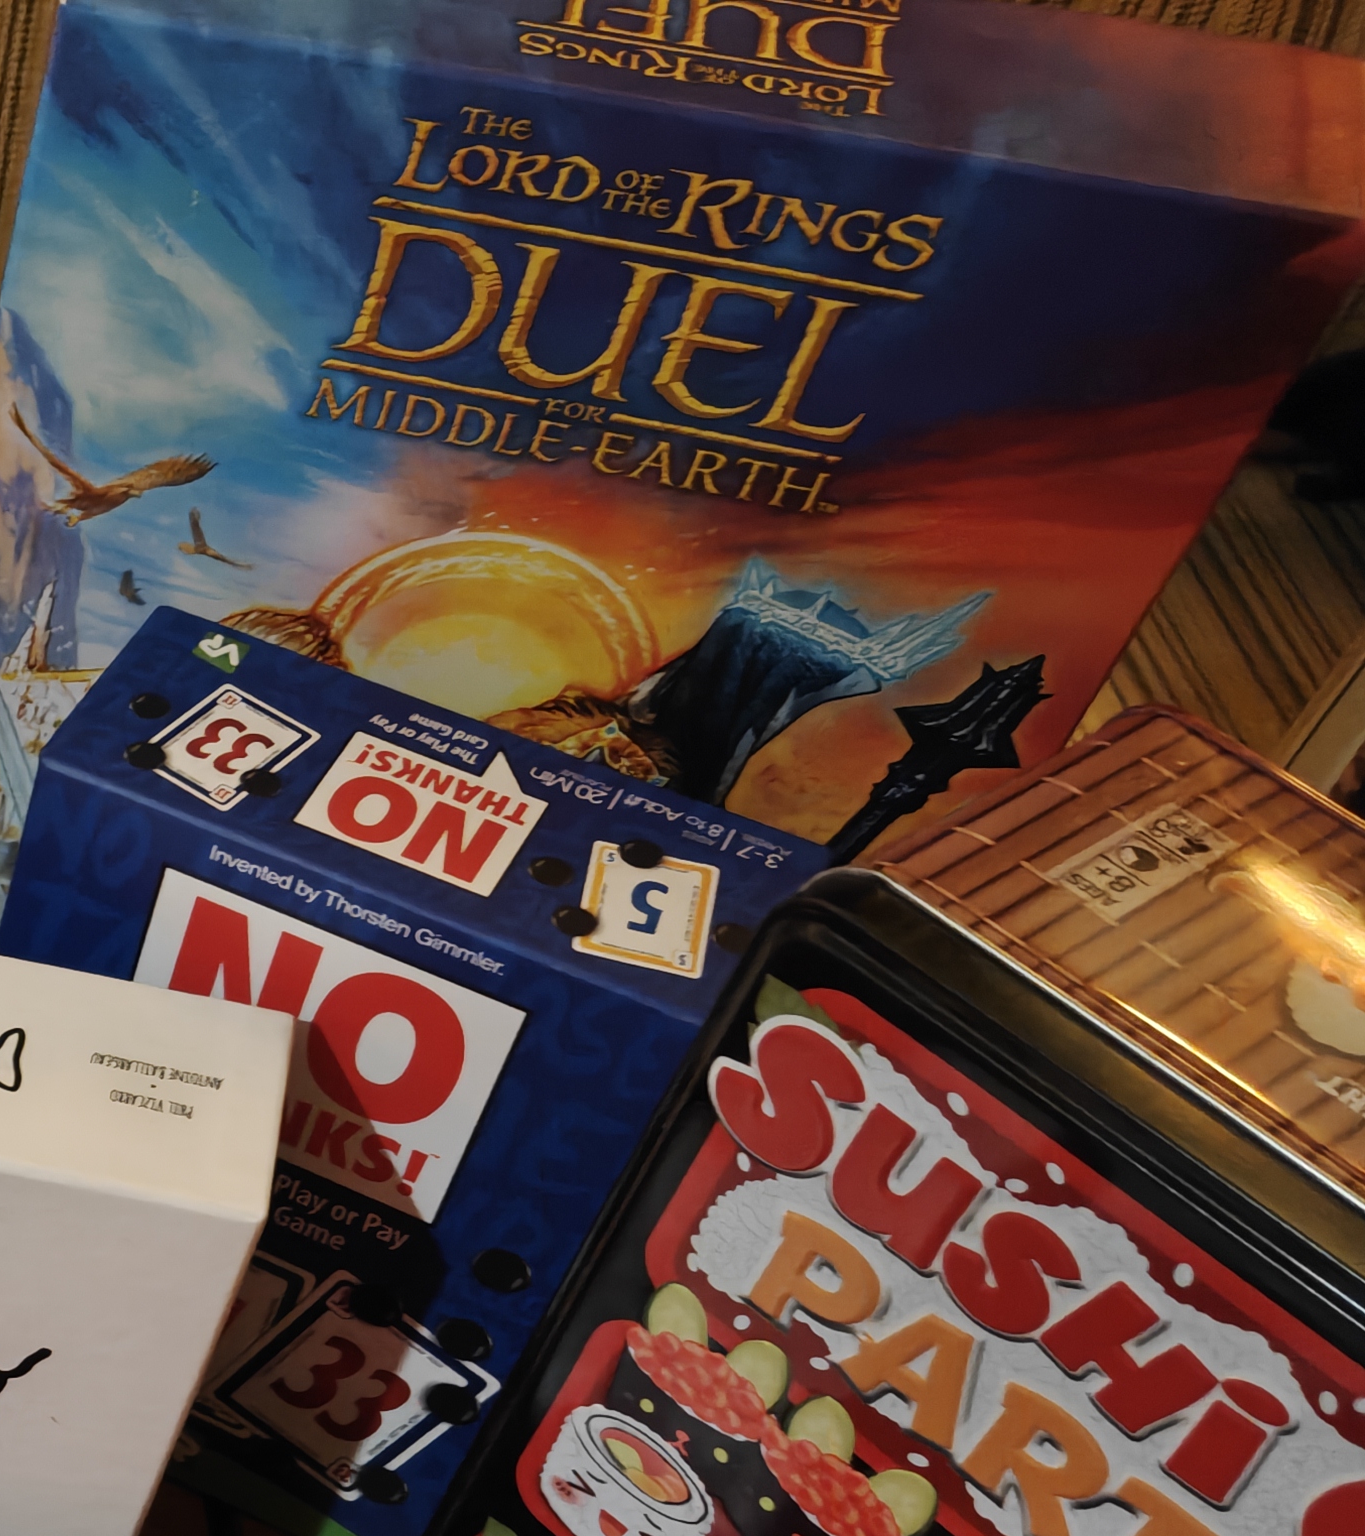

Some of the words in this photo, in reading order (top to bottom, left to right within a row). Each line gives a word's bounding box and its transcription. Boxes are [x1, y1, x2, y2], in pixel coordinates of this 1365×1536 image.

[518, 32, 696, 83] RINGS
[742, 73, 887, 116] LORD
[460, 106, 533, 141] THE
[392, 117, 602, 206] LORD
[615, 169, 665, 196] OF
[602, 188, 672, 219] THE
[657, 167, 944, 274] RINGS
[332, 215, 868, 443] DUEL
[544, 398, 609, 425] FOR
[185, 718, 276, 776] 33
[369, 714, 396, 734] Pay
[450, 745, 480, 765] The
[346, 743, 532, 827] THANKS!
[574, 784, 609, 805] 20
[325, 776, 509, 884] NO
[208, 843, 293, 890] Invented
[294, 874, 322, 904] by
[324, 884, 411, 941] Thorsten
[627, 880, 669, 935] 5
[168, 895, 466, 1127] NO
[272, 1205, 346, 1252] Game
[273, 1172, 329, 1218] Play
[330, 1201, 360, 1226] or
[361, 1210, 410, 1252] Pay
[271, 1335, 412, 1442] 33
